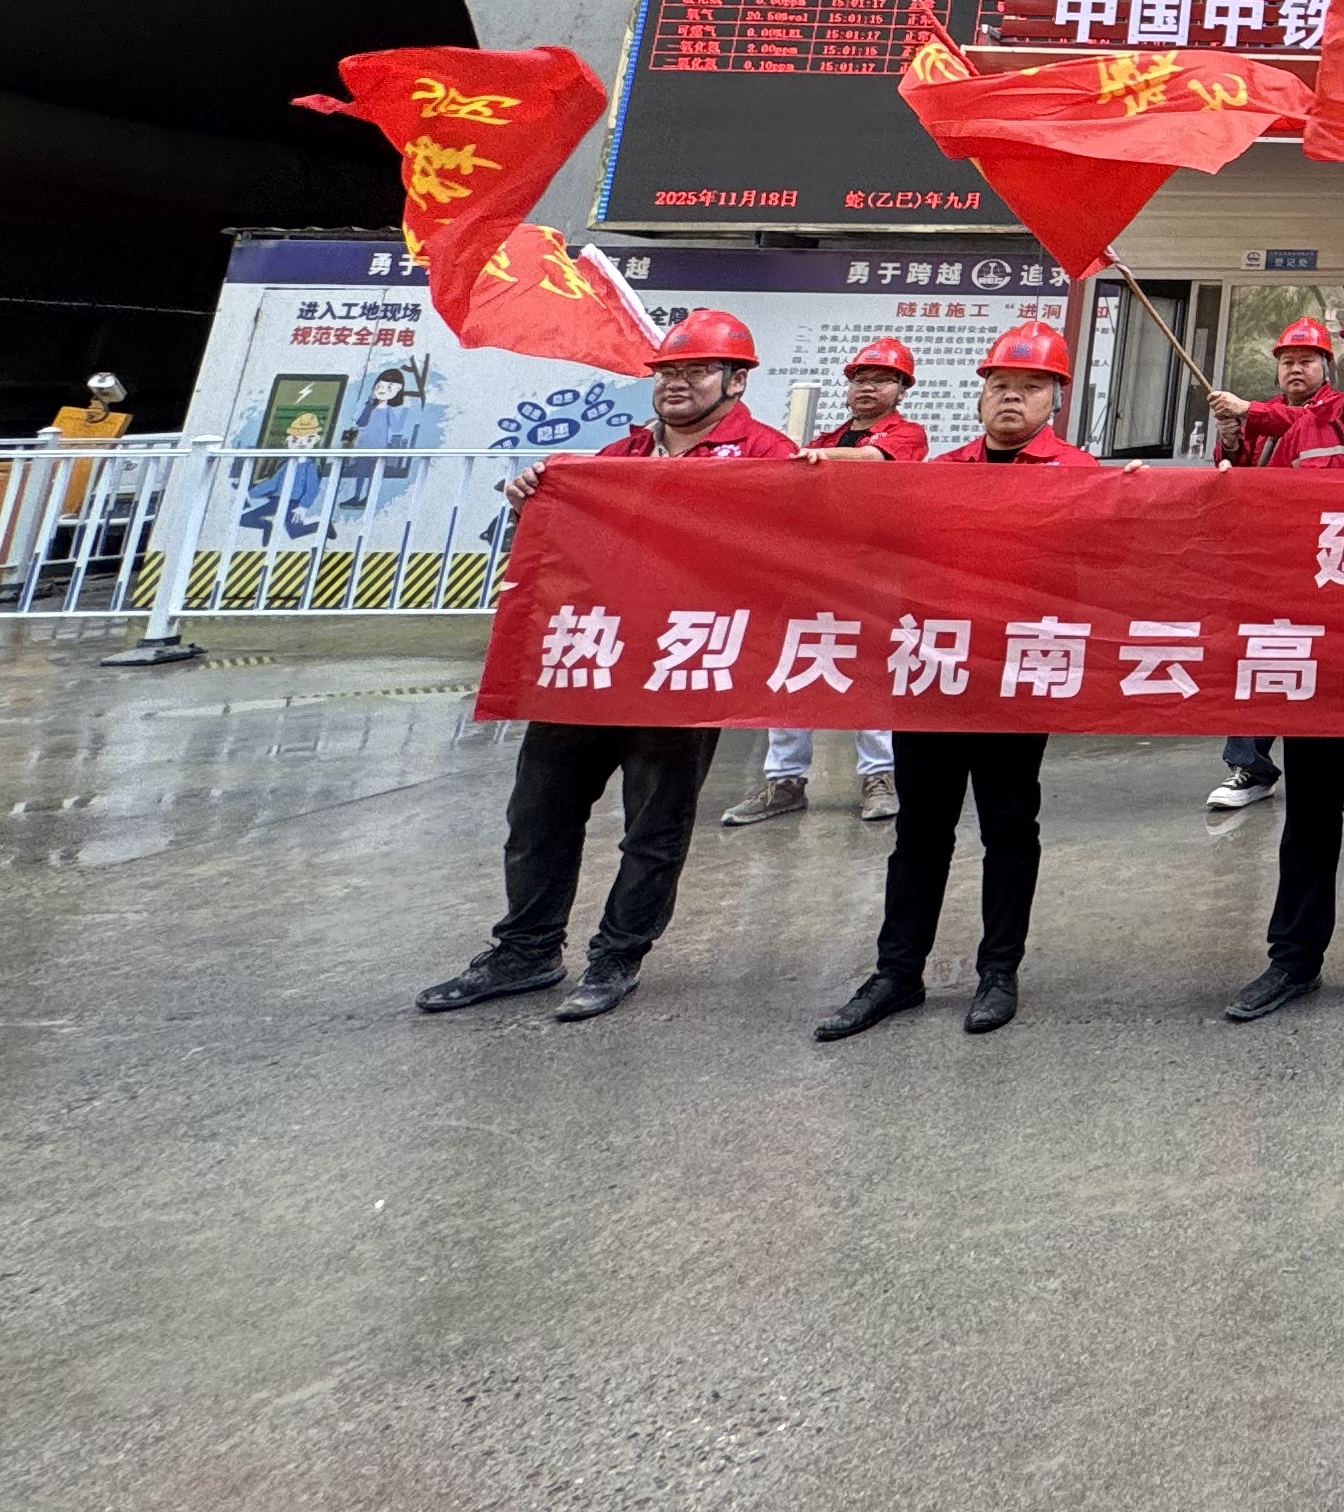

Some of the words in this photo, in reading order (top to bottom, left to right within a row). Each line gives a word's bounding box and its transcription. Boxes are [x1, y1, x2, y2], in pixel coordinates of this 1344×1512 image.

[654, 190, 798, 208] 2025年11月18日
[846, 261, 963, 285] 勇于跨越
[297, 301, 421, 323] 进入工地现场
[896, 302, 990, 318] 隧道施工
[290, 326, 416, 348] 规范安全用电
